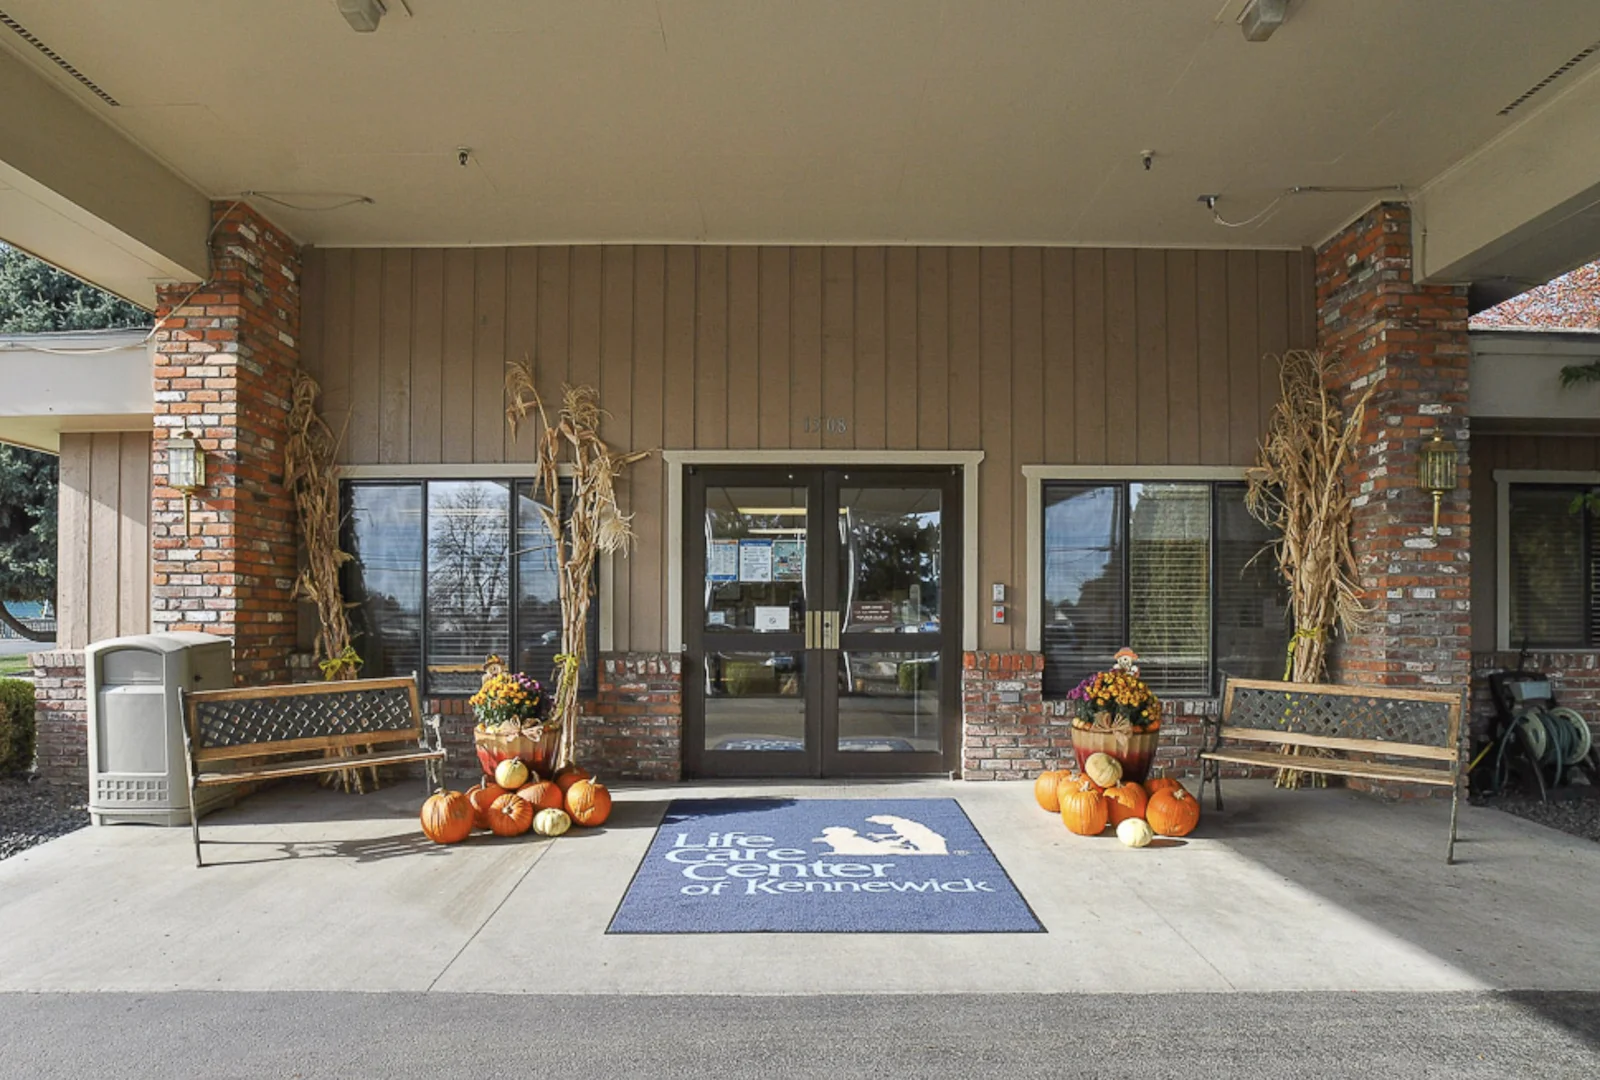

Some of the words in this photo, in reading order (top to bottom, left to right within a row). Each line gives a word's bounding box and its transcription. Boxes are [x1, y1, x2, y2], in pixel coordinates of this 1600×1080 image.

[672, 832, 775, 848] Life
[664, 848, 807, 864] Care
[681, 861, 895, 881] Center
[680, 881, 732, 895] of
[744, 878, 996, 894] Kennewick
